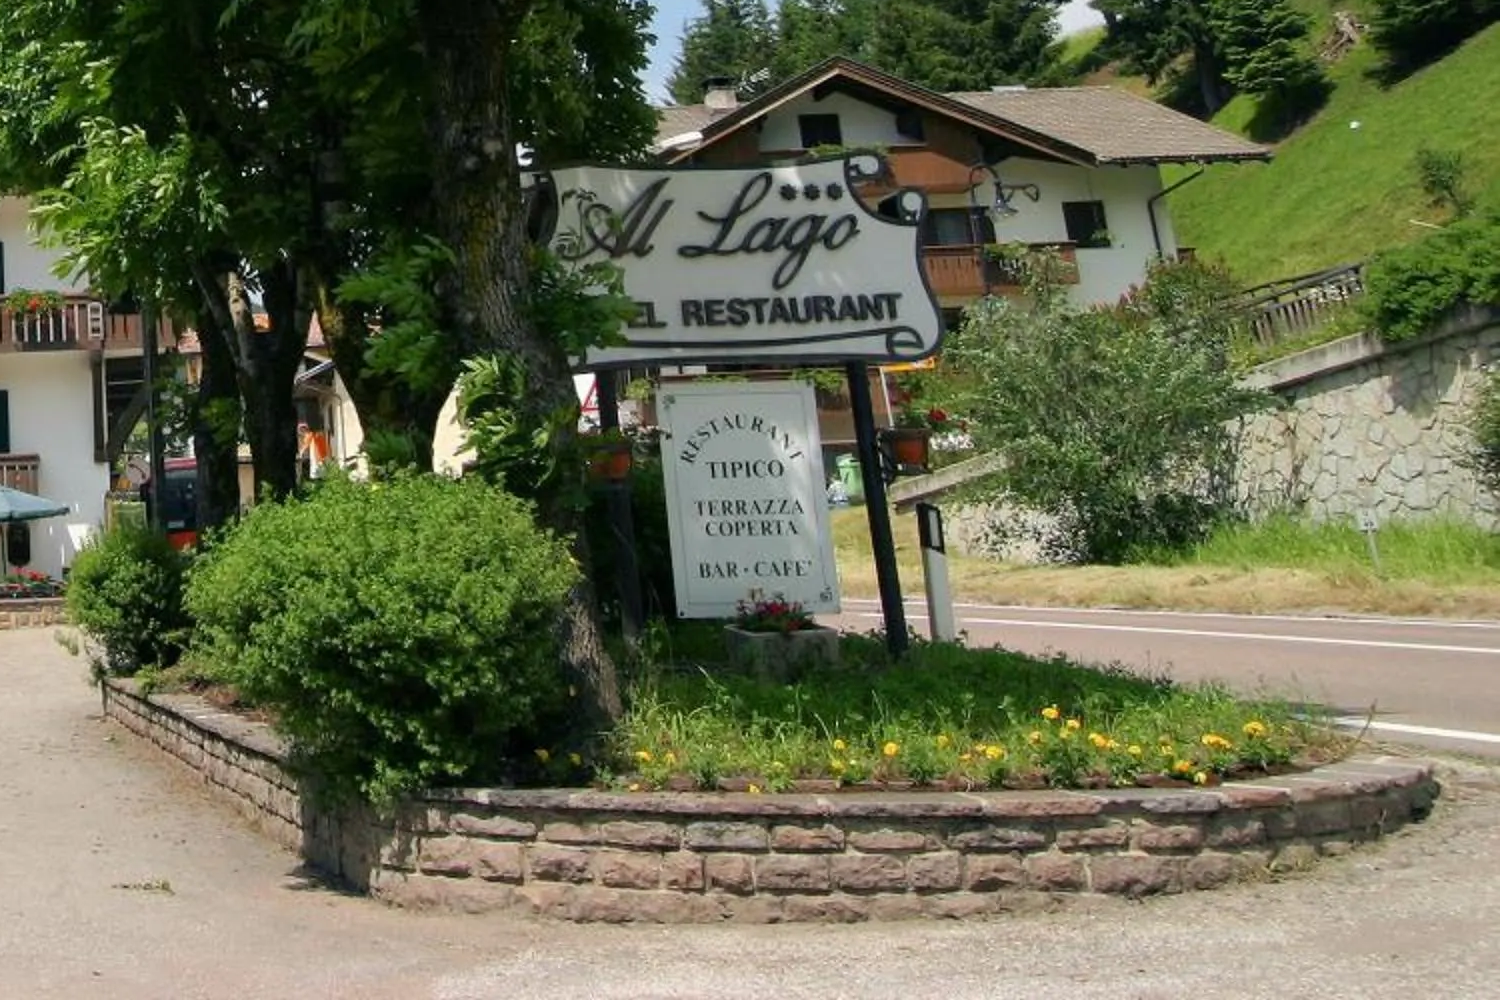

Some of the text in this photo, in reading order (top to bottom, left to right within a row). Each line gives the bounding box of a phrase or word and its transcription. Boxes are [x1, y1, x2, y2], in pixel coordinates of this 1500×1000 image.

[560, 172, 860, 290] Al Lago
[681, 292, 902, 327] RESTAURANT
[680, 413, 804, 464] RESTAURANT
[706, 459, 784, 479] TIPICO
[694, 498, 804, 517] TERRAZZA
[705, 519, 799, 537] COPERTA
[699, 561, 739, 579] BAR
